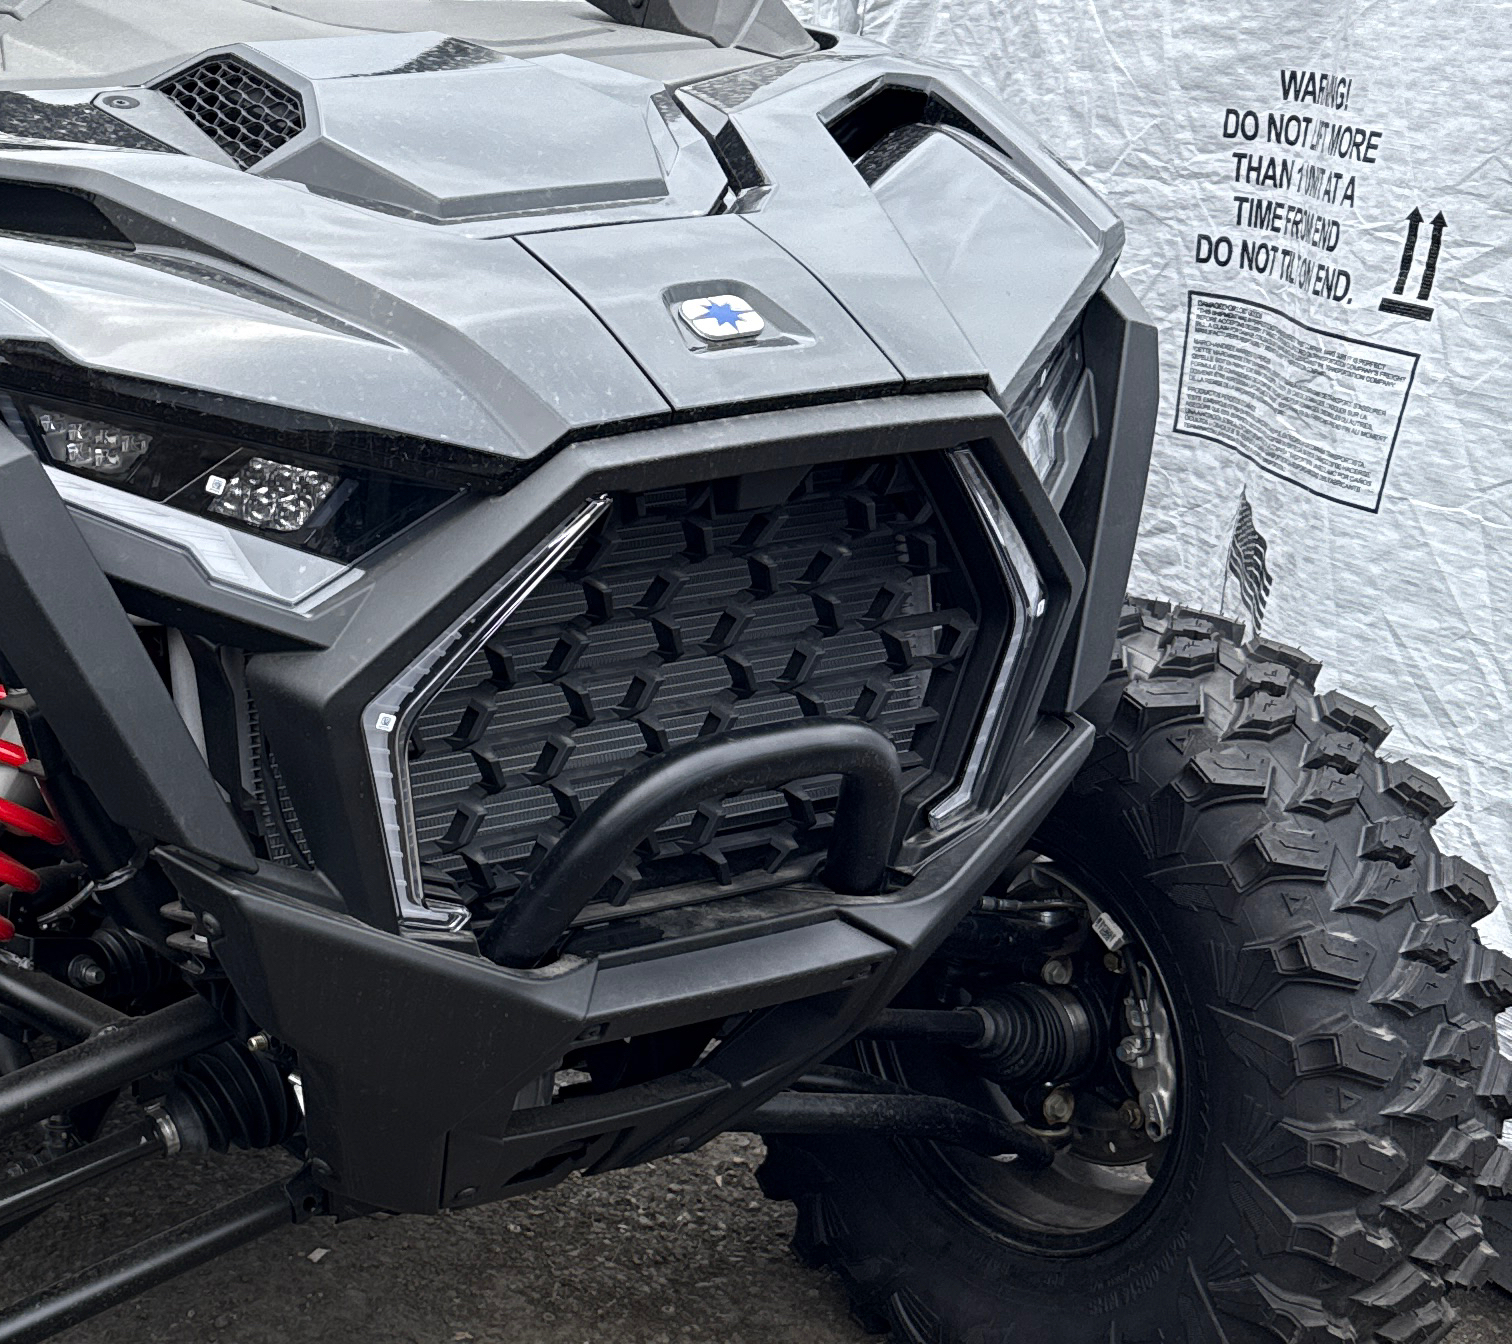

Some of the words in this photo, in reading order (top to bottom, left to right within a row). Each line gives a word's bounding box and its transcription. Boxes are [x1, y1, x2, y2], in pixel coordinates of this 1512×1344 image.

[1222, 108, 1260, 141] DO
[1267, 112, 1313, 148] NOT
[1327, 122, 1383, 164] MORE
[1232, 151, 1296, 191] THAN
[1296, 162, 1305, 193] 1
[1322, 170, 1344, 205] AT
[1339, 176, 1356, 208] A
[1233, 195, 1285, 233] TIME
[1311, 215, 1341, 253] END
[1195, 233, 1234, 268] DO
[1239, 238, 1280, 277] NOT
[1311, 263, 1353, 305] END.
